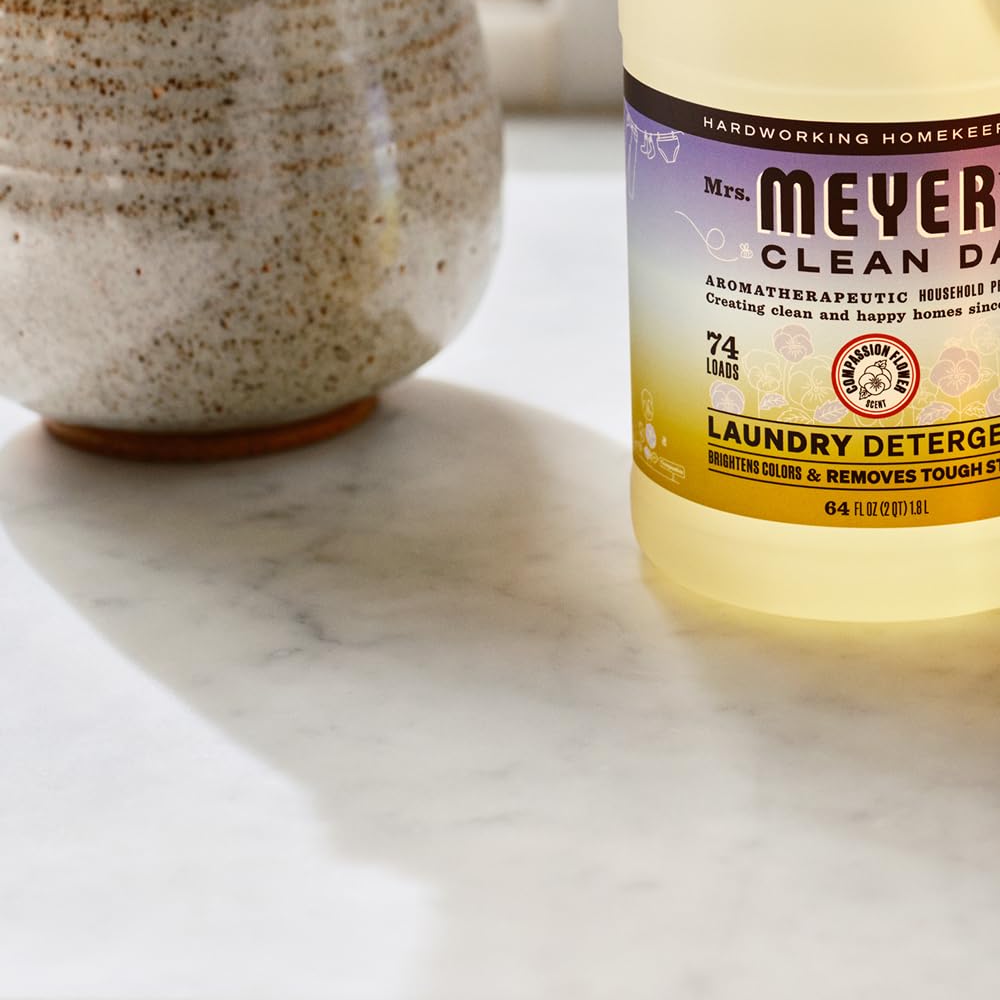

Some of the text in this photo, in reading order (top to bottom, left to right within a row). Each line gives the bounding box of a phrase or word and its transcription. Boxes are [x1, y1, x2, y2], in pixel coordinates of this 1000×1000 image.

[703, 116, 869, 144] HARDWORKING
[704, 175, 750, 202] Mrs.
[761, 244, 929, 275] CLEAN
[705, 274, 908, 304] AROMATHERAPEUTIC
[919, 282, 984, 303] HOUSEHOLD
[705, 292, 765, 316] Creating
[771, 305, 813, 320] clean
[819, 310, 850, 321] and
[856, 310, 907, 323] happy
[912, 308, 963, 320] homes
[706, 330, 739, 361] 74
[706, 357, 739, 381] LOADS
[841, 343, 910, 394] COMPASSION FLOWER
[865, 399, 887, 409] SCENT
[708, 415, 852, 457] LAUNDRY
[708, 449, 760, 475] BRIGHTENS
[762, 461, 802, 481] COLORS
[806, 468, 821, 482] &
[826, 469, 917, 485] REMOVES
[921, 461, 982, 482] TOUGH
[824, 500, 929, 518] 64 FL OZ (2 QT) 1.8 L
